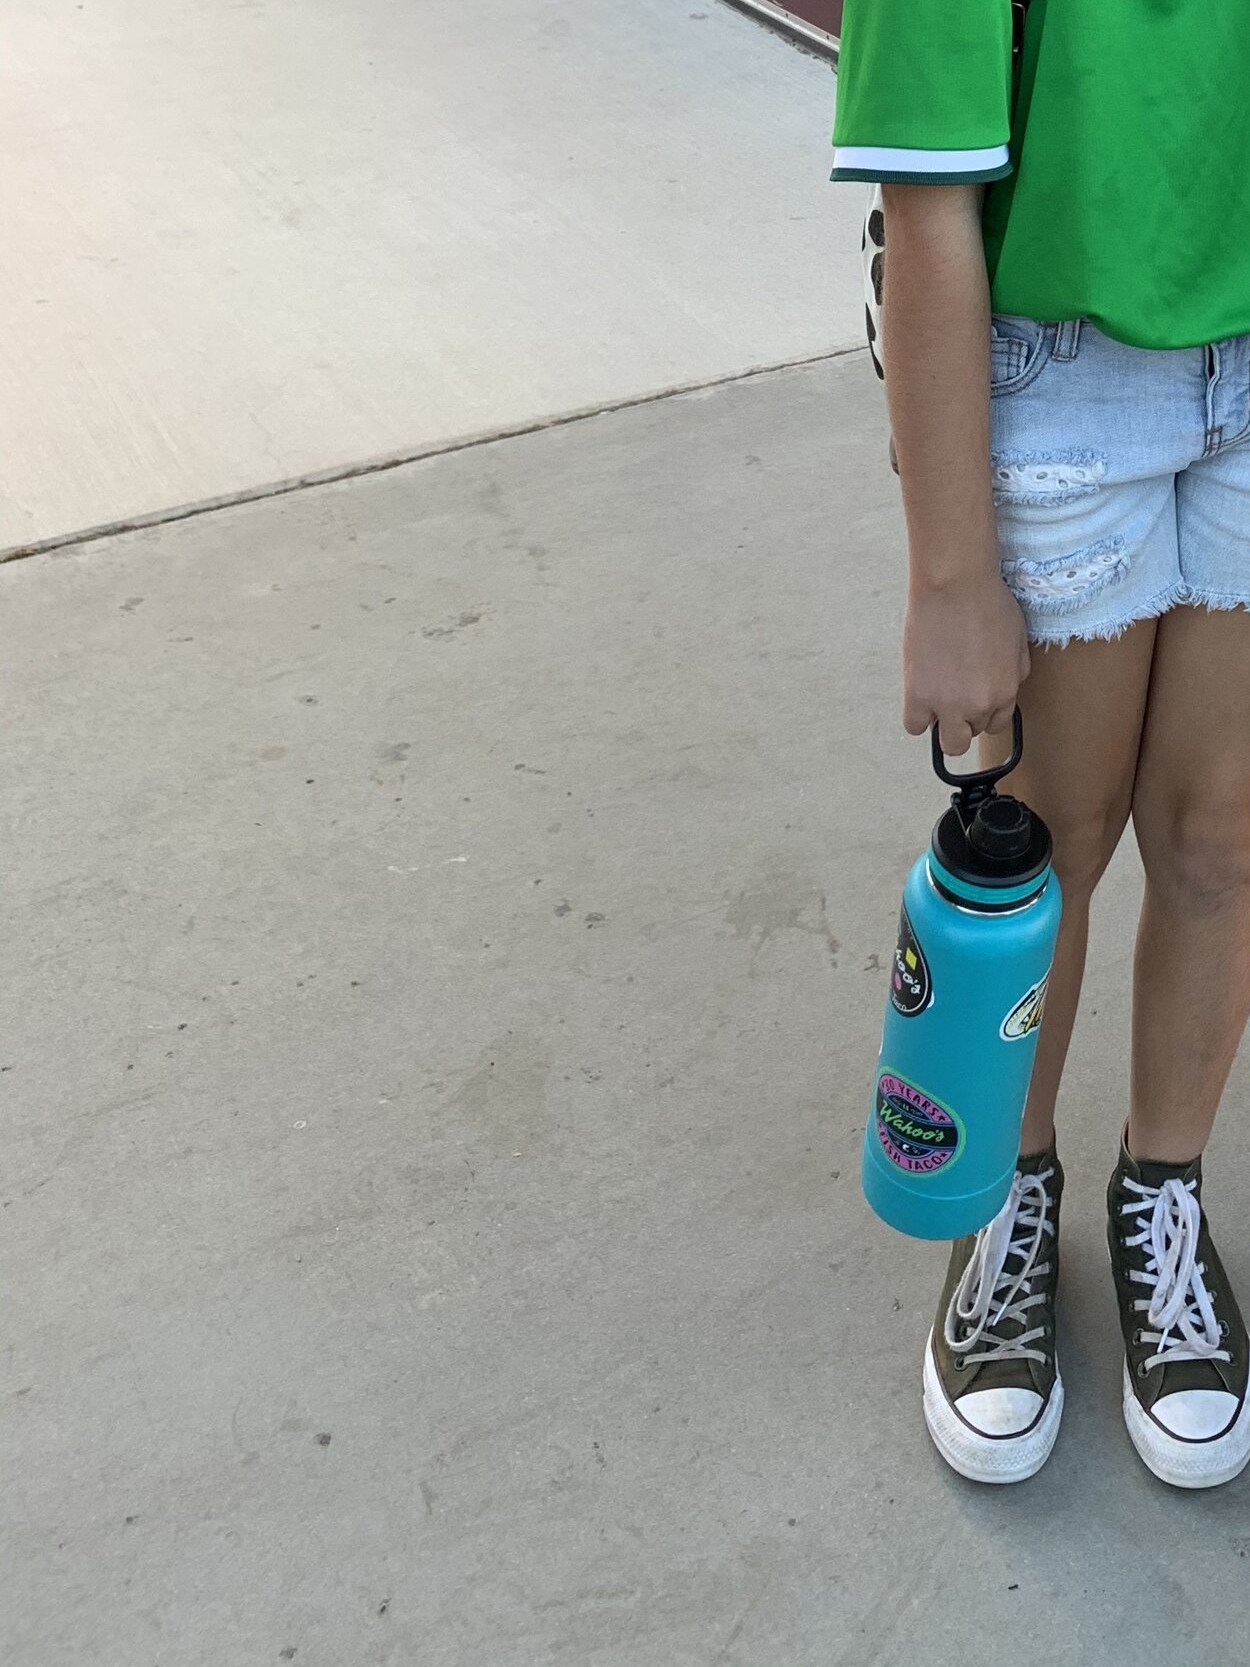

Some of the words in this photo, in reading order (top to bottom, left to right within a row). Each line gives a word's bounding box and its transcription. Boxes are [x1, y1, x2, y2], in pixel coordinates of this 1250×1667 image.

[898, 1082, 940, 1118] YEARS
[880, 1099, 945, 1143] Wahoo's
[907, 1156, 943, 1171] TACO
